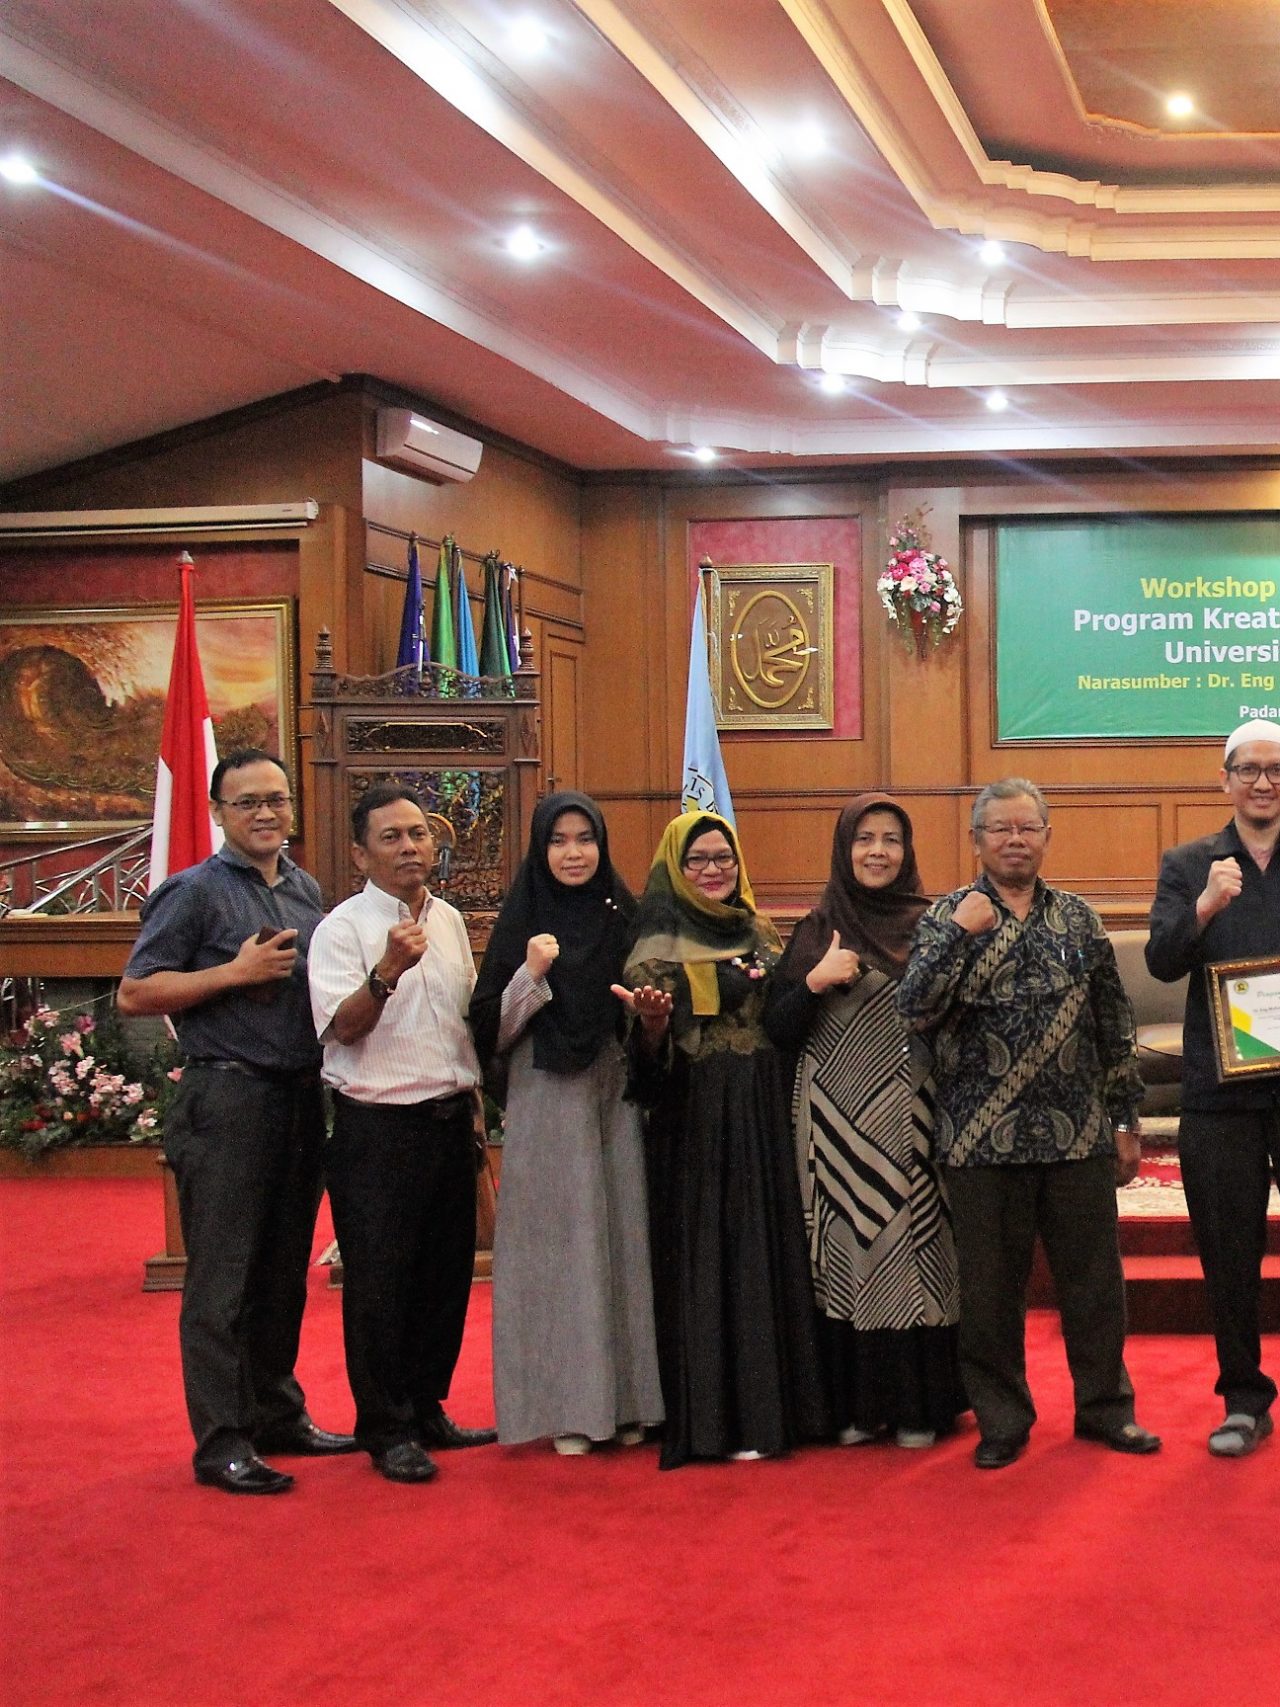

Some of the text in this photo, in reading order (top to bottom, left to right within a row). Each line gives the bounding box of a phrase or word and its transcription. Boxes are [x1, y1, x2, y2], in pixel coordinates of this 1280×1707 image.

[1140, 576, 1276, 602] Workshop
[1074, 609, 1193, 635] Program
[1078, 673, 1190, 690] Narasumber
[1208, 673, 1235, 688] Dr.
[1241, 673, 1275, 691] Eng
